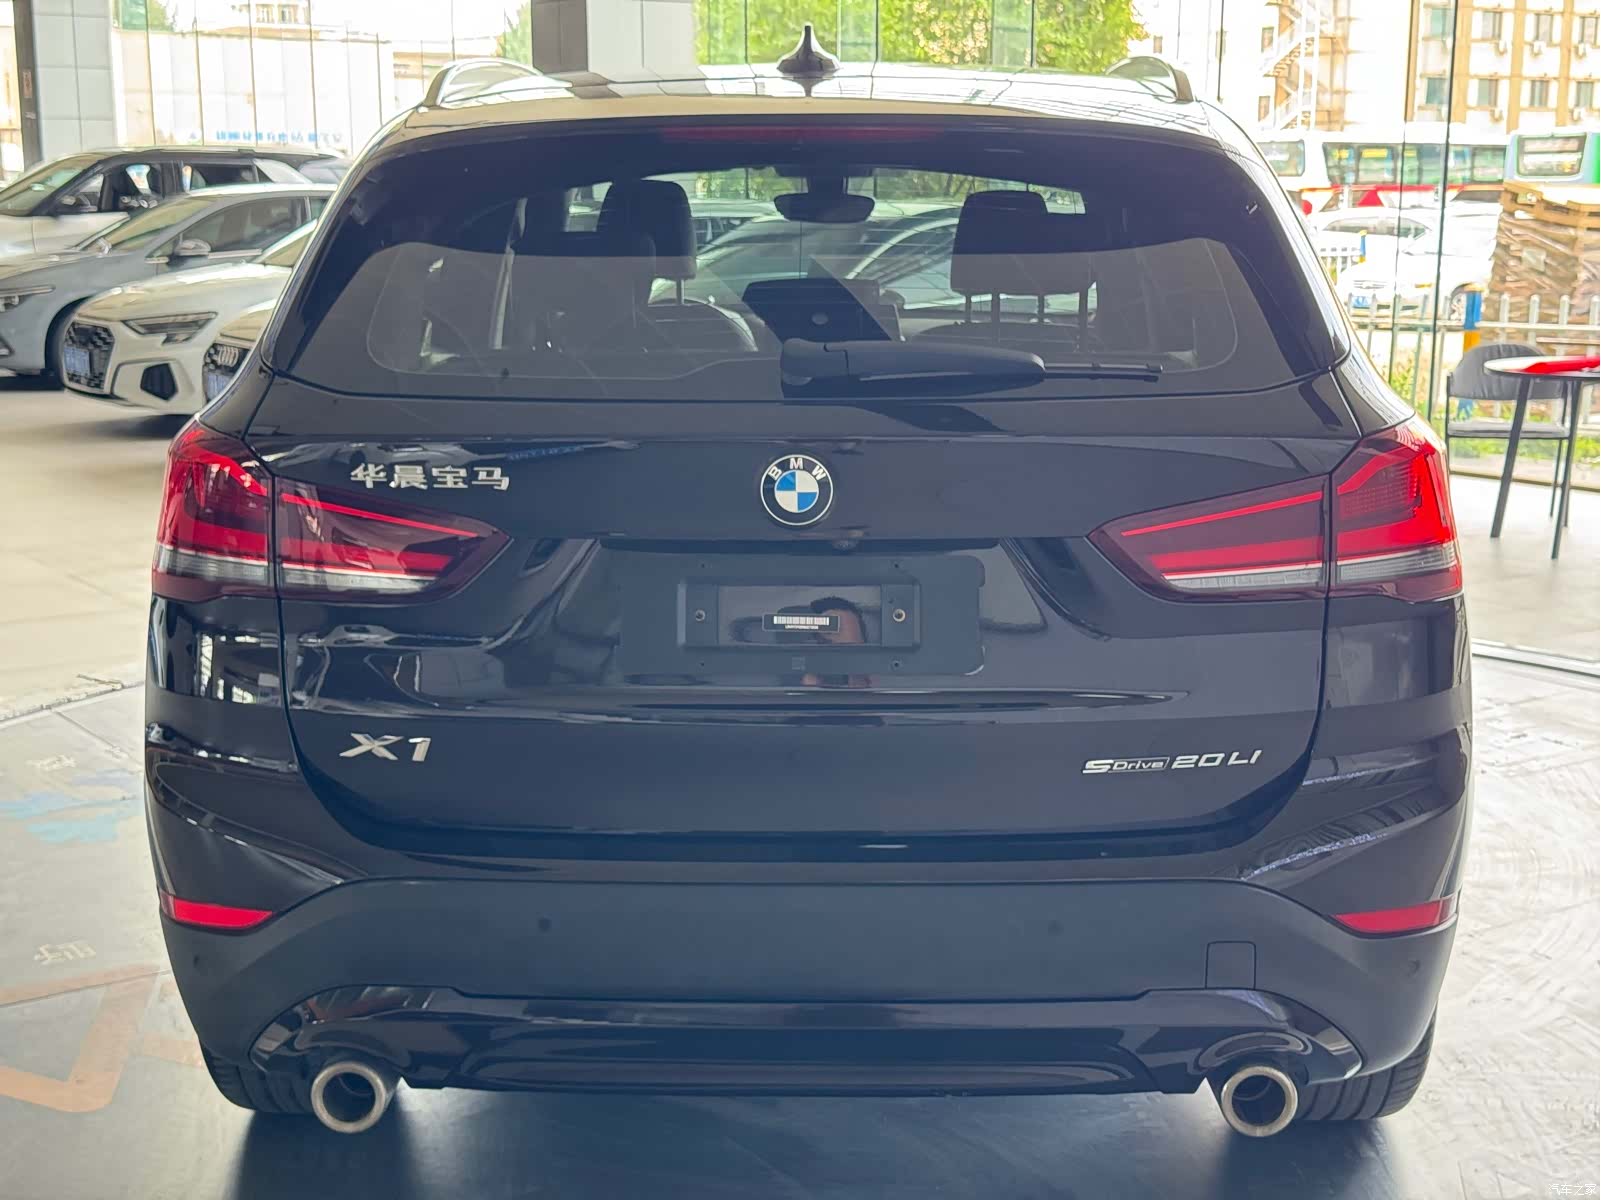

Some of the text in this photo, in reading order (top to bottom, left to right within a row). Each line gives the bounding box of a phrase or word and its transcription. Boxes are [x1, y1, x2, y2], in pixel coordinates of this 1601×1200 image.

[350, 463, 509, 491] 华晨宝马
[768, 457, 826, 480] BMW
[339, 732, 431, 762] X1
